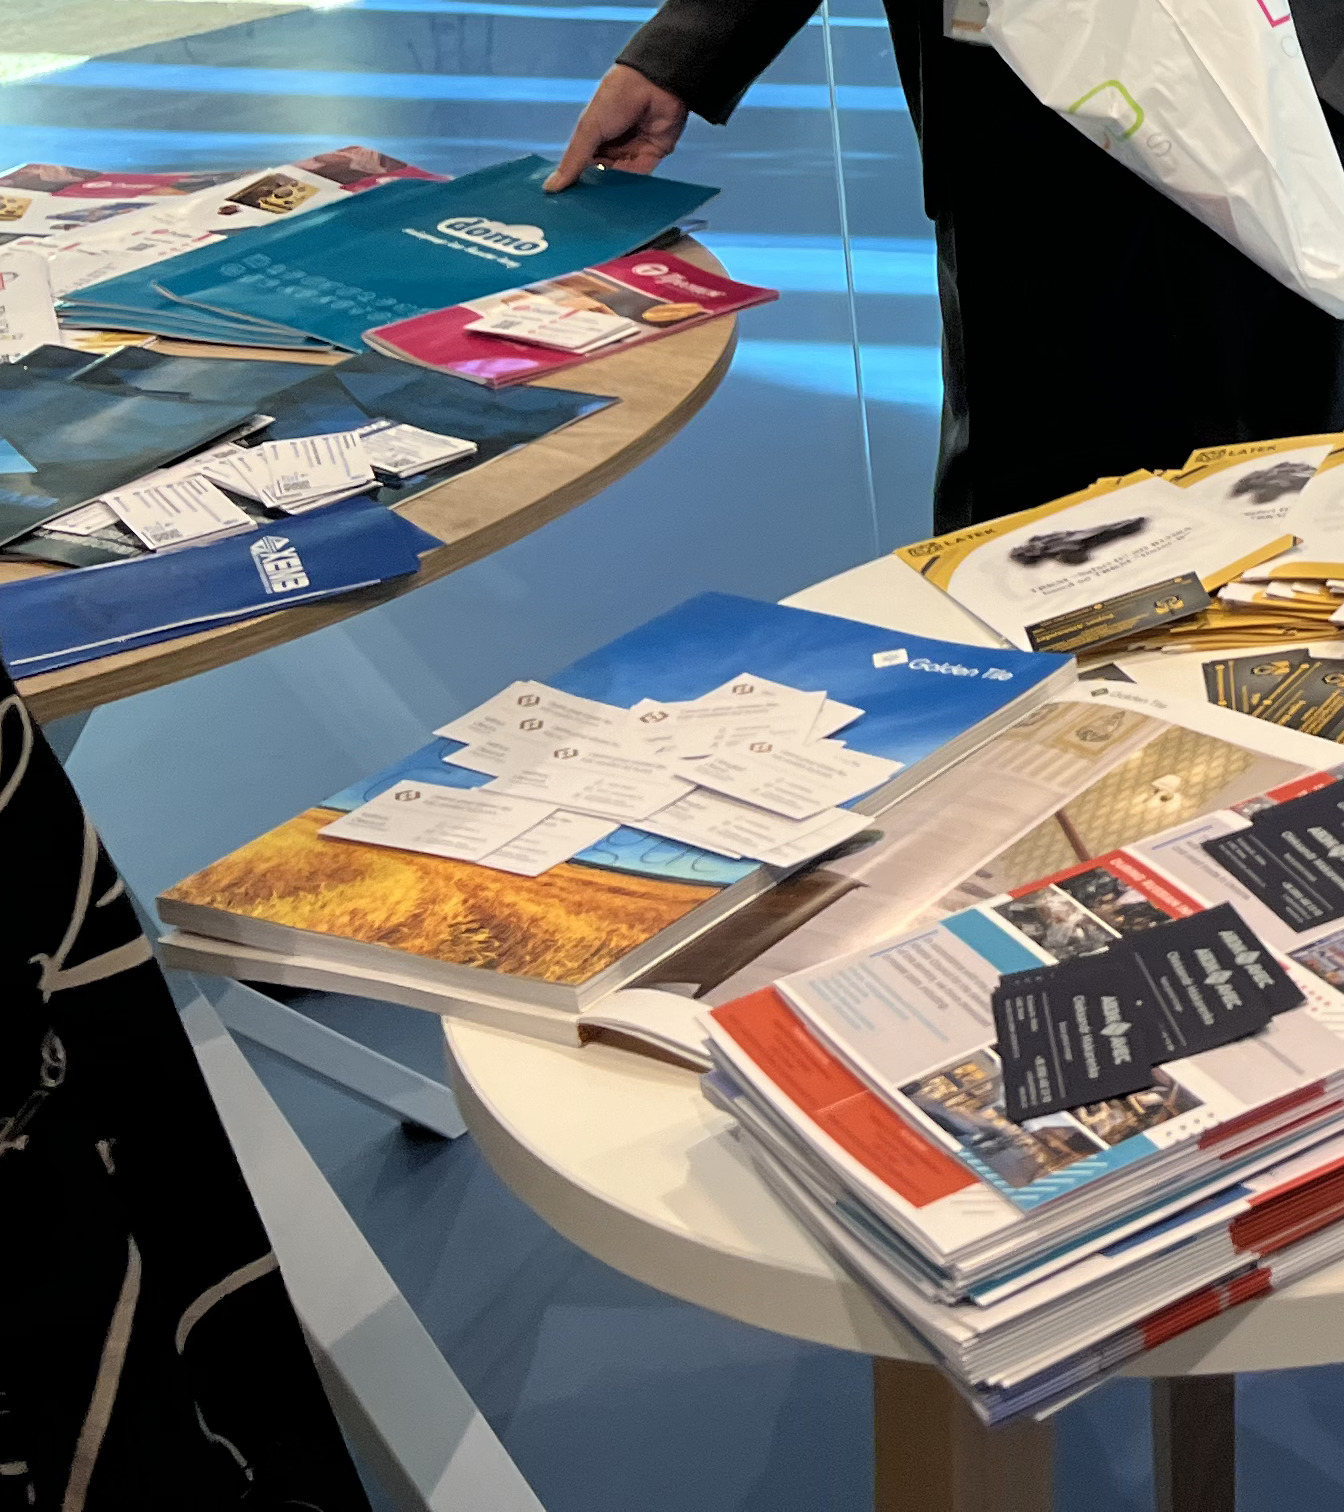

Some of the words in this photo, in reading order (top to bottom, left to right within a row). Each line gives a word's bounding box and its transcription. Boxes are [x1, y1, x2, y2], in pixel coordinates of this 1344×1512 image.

[445, 218, 540, 252] domo
[1229, 445, 1277, 457] LATEK
[943, 528, 996, 546] LATEK
[909, 658, 979, 678] Golden
